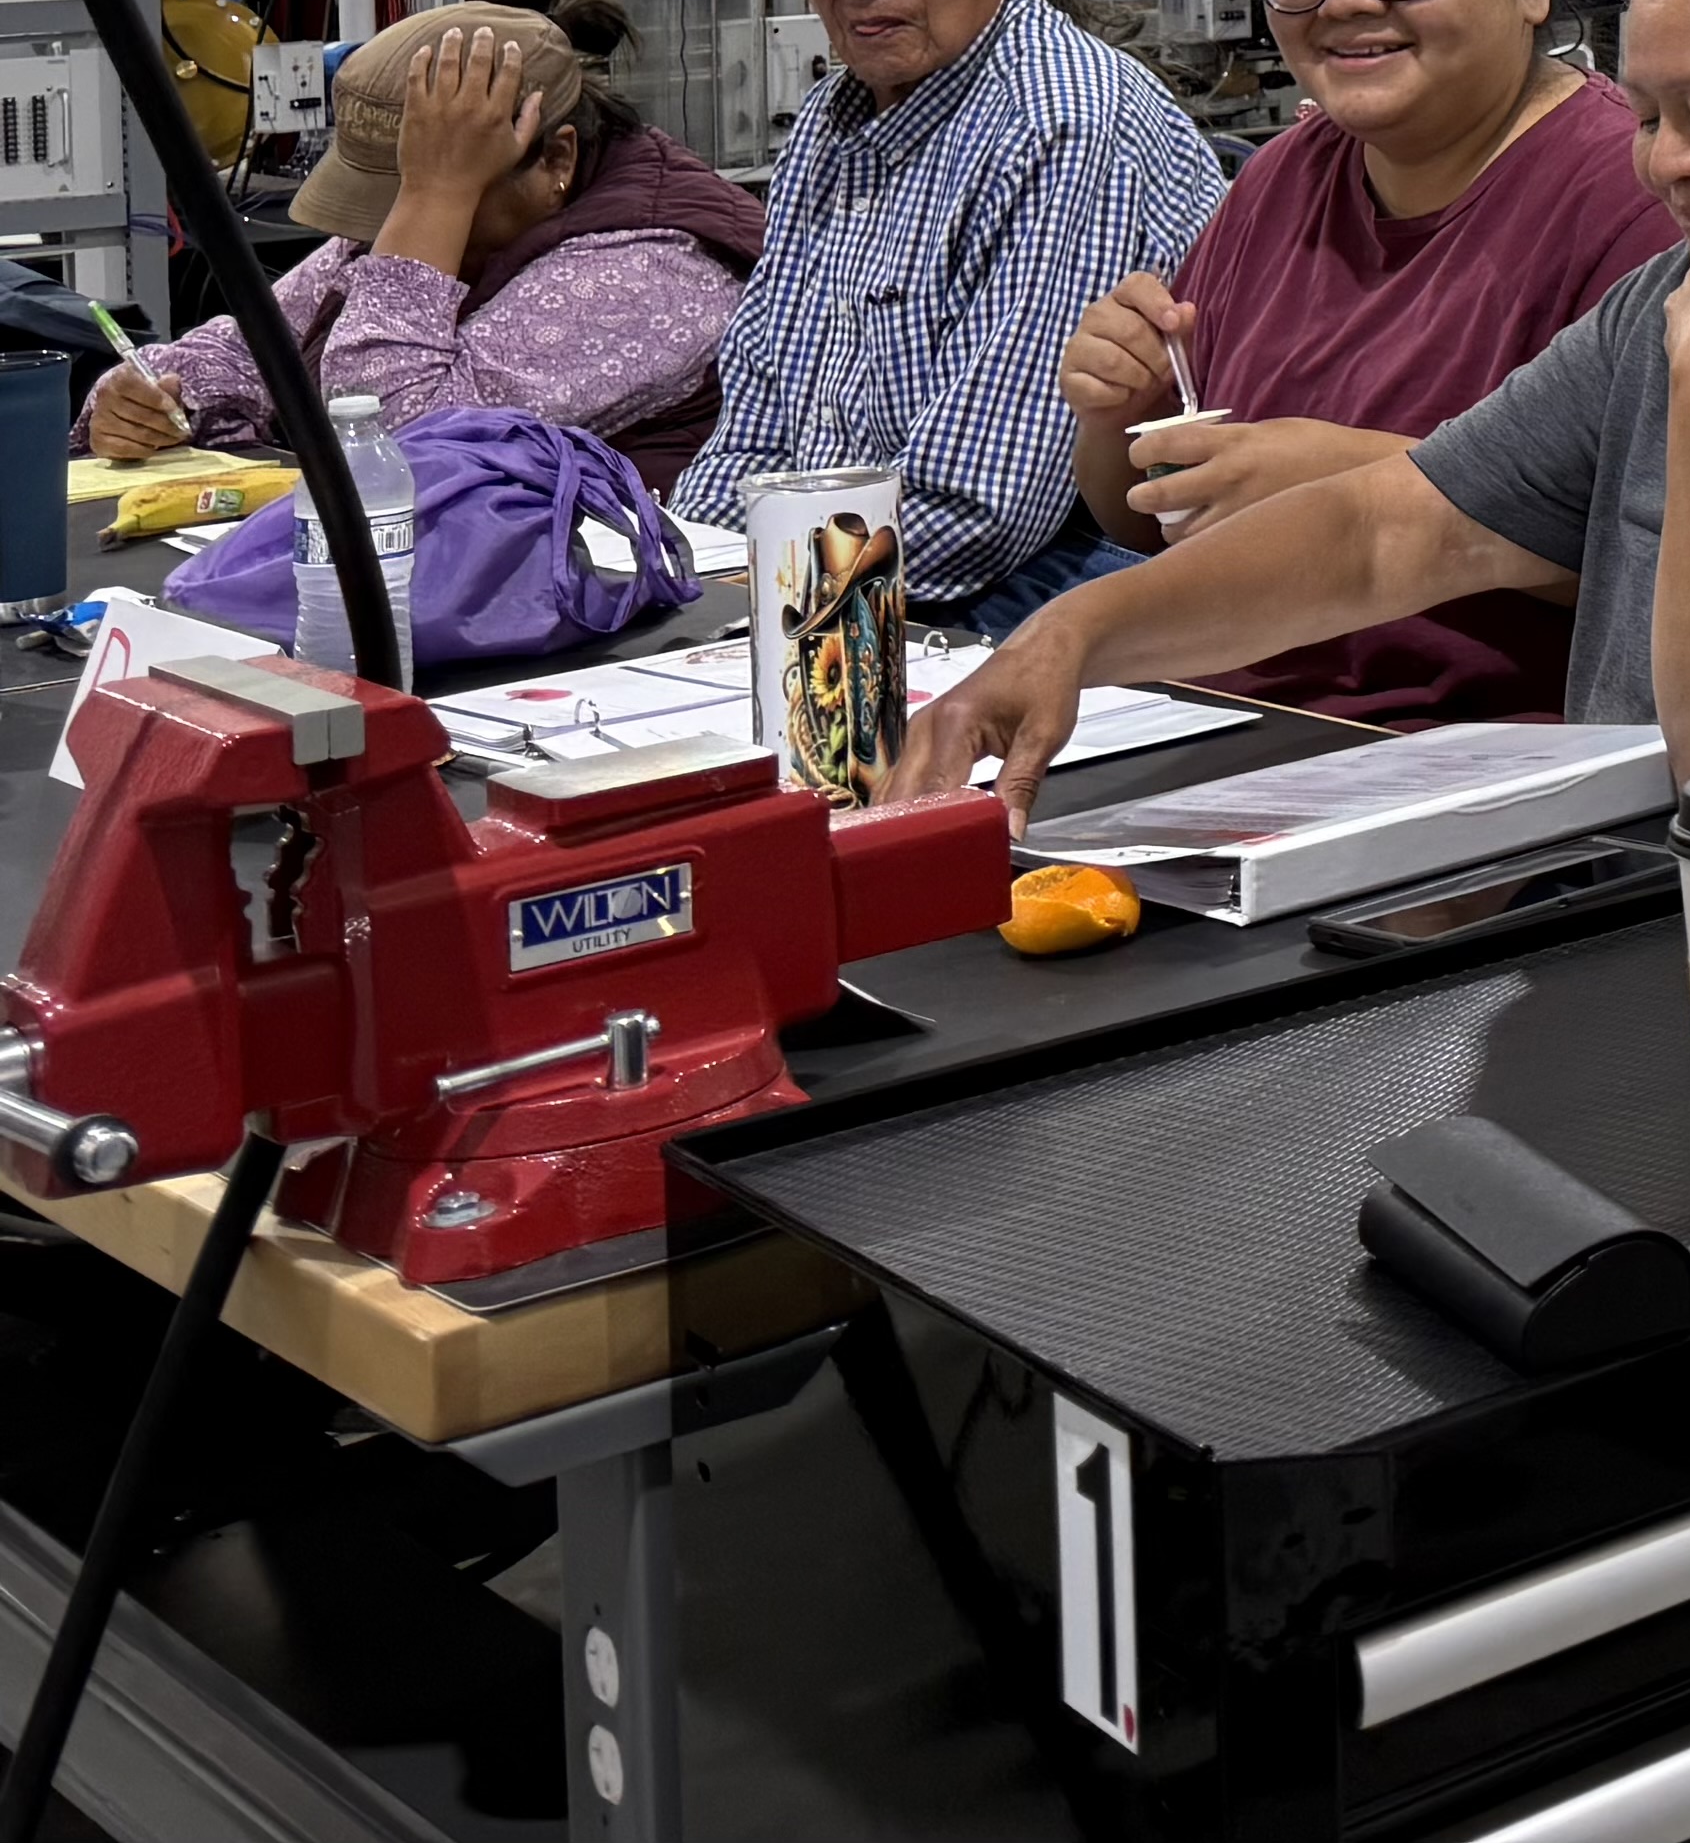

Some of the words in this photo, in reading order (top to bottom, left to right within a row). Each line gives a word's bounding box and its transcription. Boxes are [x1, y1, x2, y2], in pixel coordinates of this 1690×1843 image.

[531, 875, 671, 938] WILTON
[572, 928, 632, 953] UTILITY
[1076, 1442, 1119, 1728] 1
